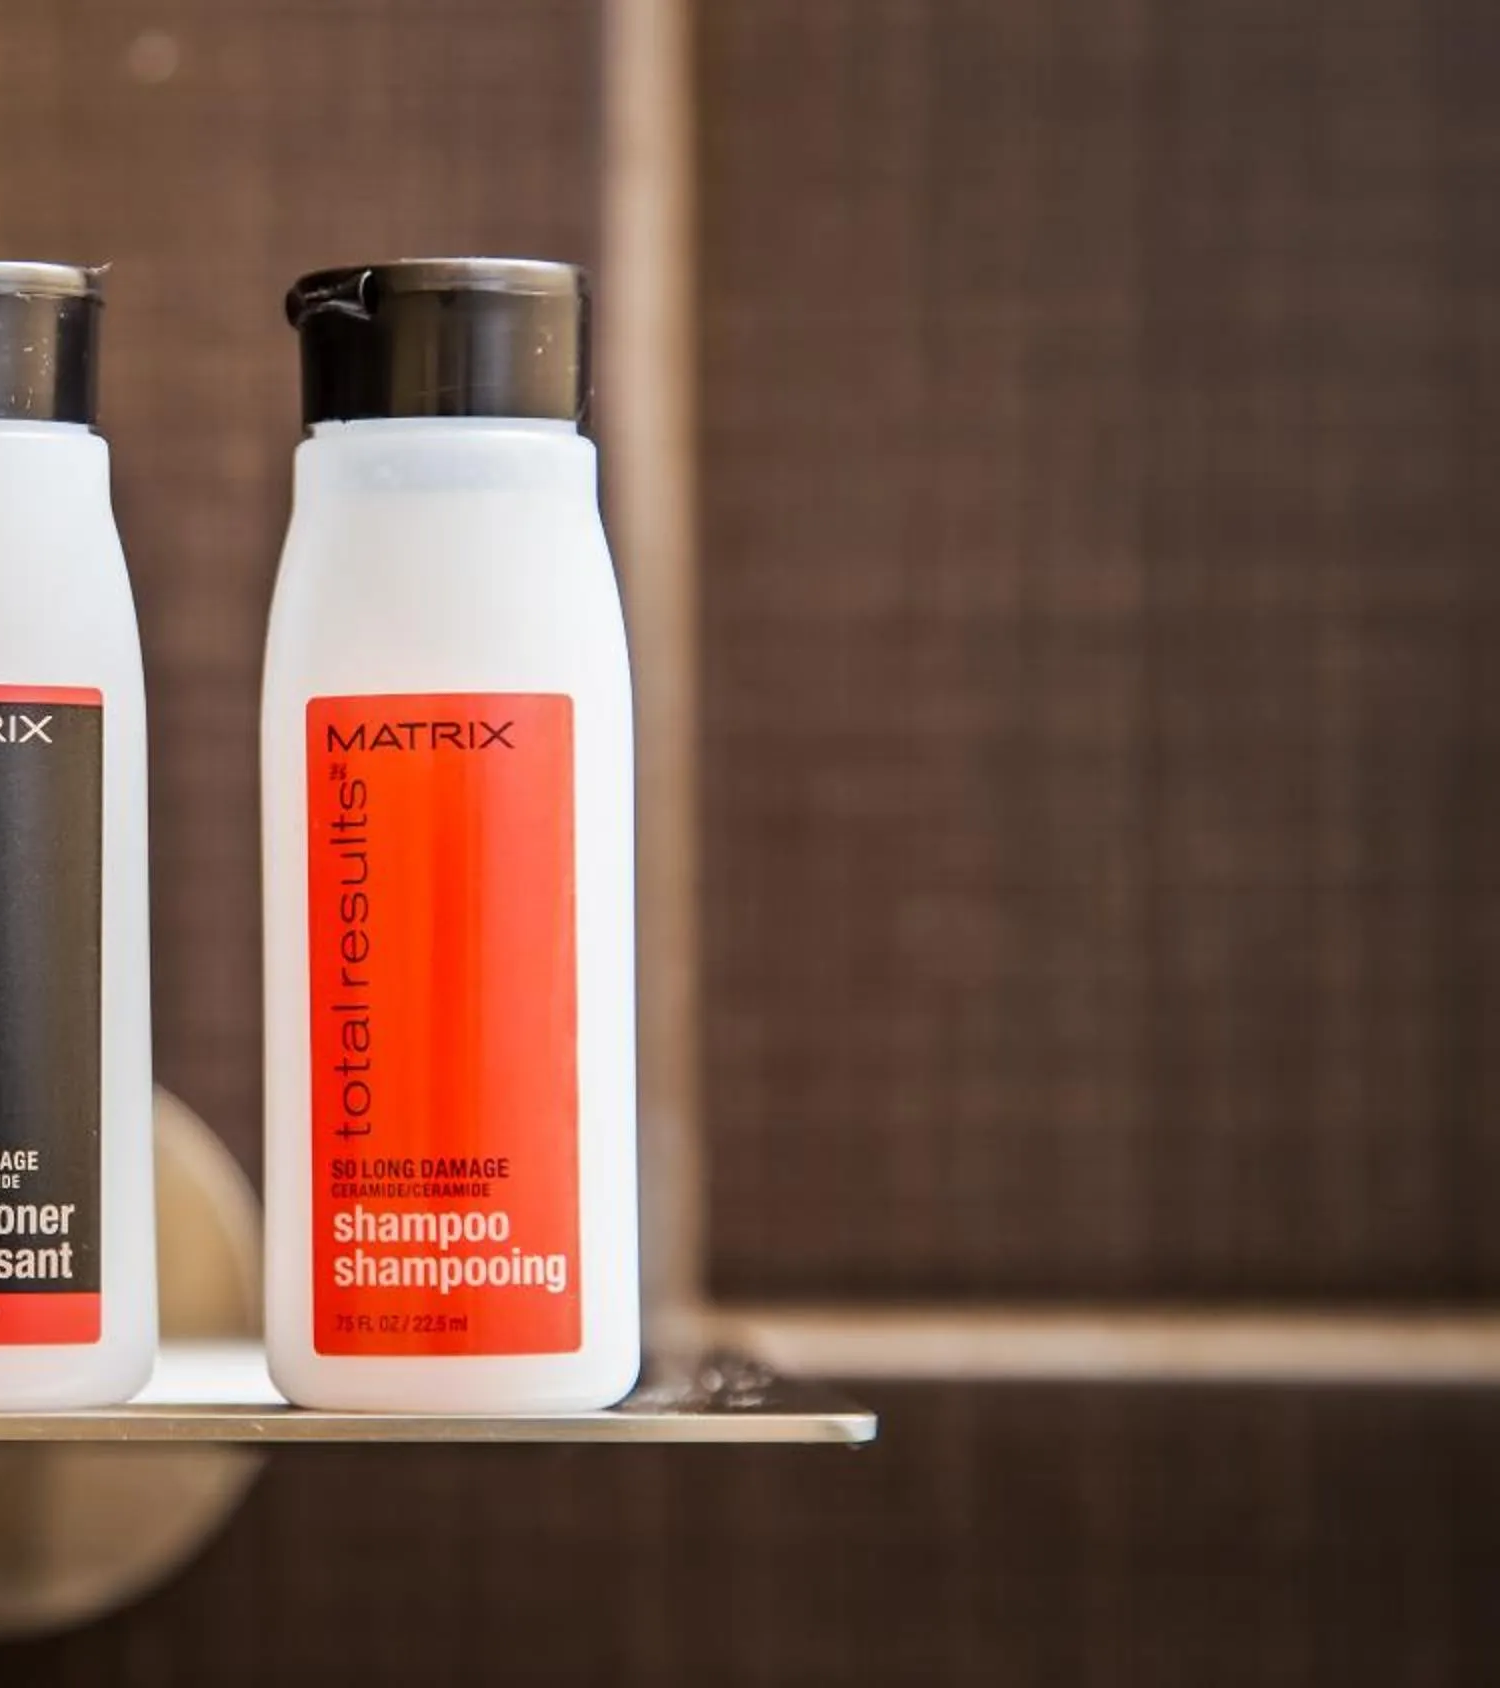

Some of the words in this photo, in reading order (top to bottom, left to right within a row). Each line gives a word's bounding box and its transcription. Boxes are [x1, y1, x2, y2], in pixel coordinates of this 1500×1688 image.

[327, 721, 515, 752] MATRIX
[329, 778, 369, 987] results
[331, 1004, 371, 1142] total
[331, 1158, 357, 1179] SO
[362, 1158, 415, 1179] LONG
[421, 1158, 510, 1178] DAMAGE
[333, 1204, 510, 1250] shampoo
[333, 1247, 567, 1295] shampooing
[449, 1315, 468, 1332] ml
